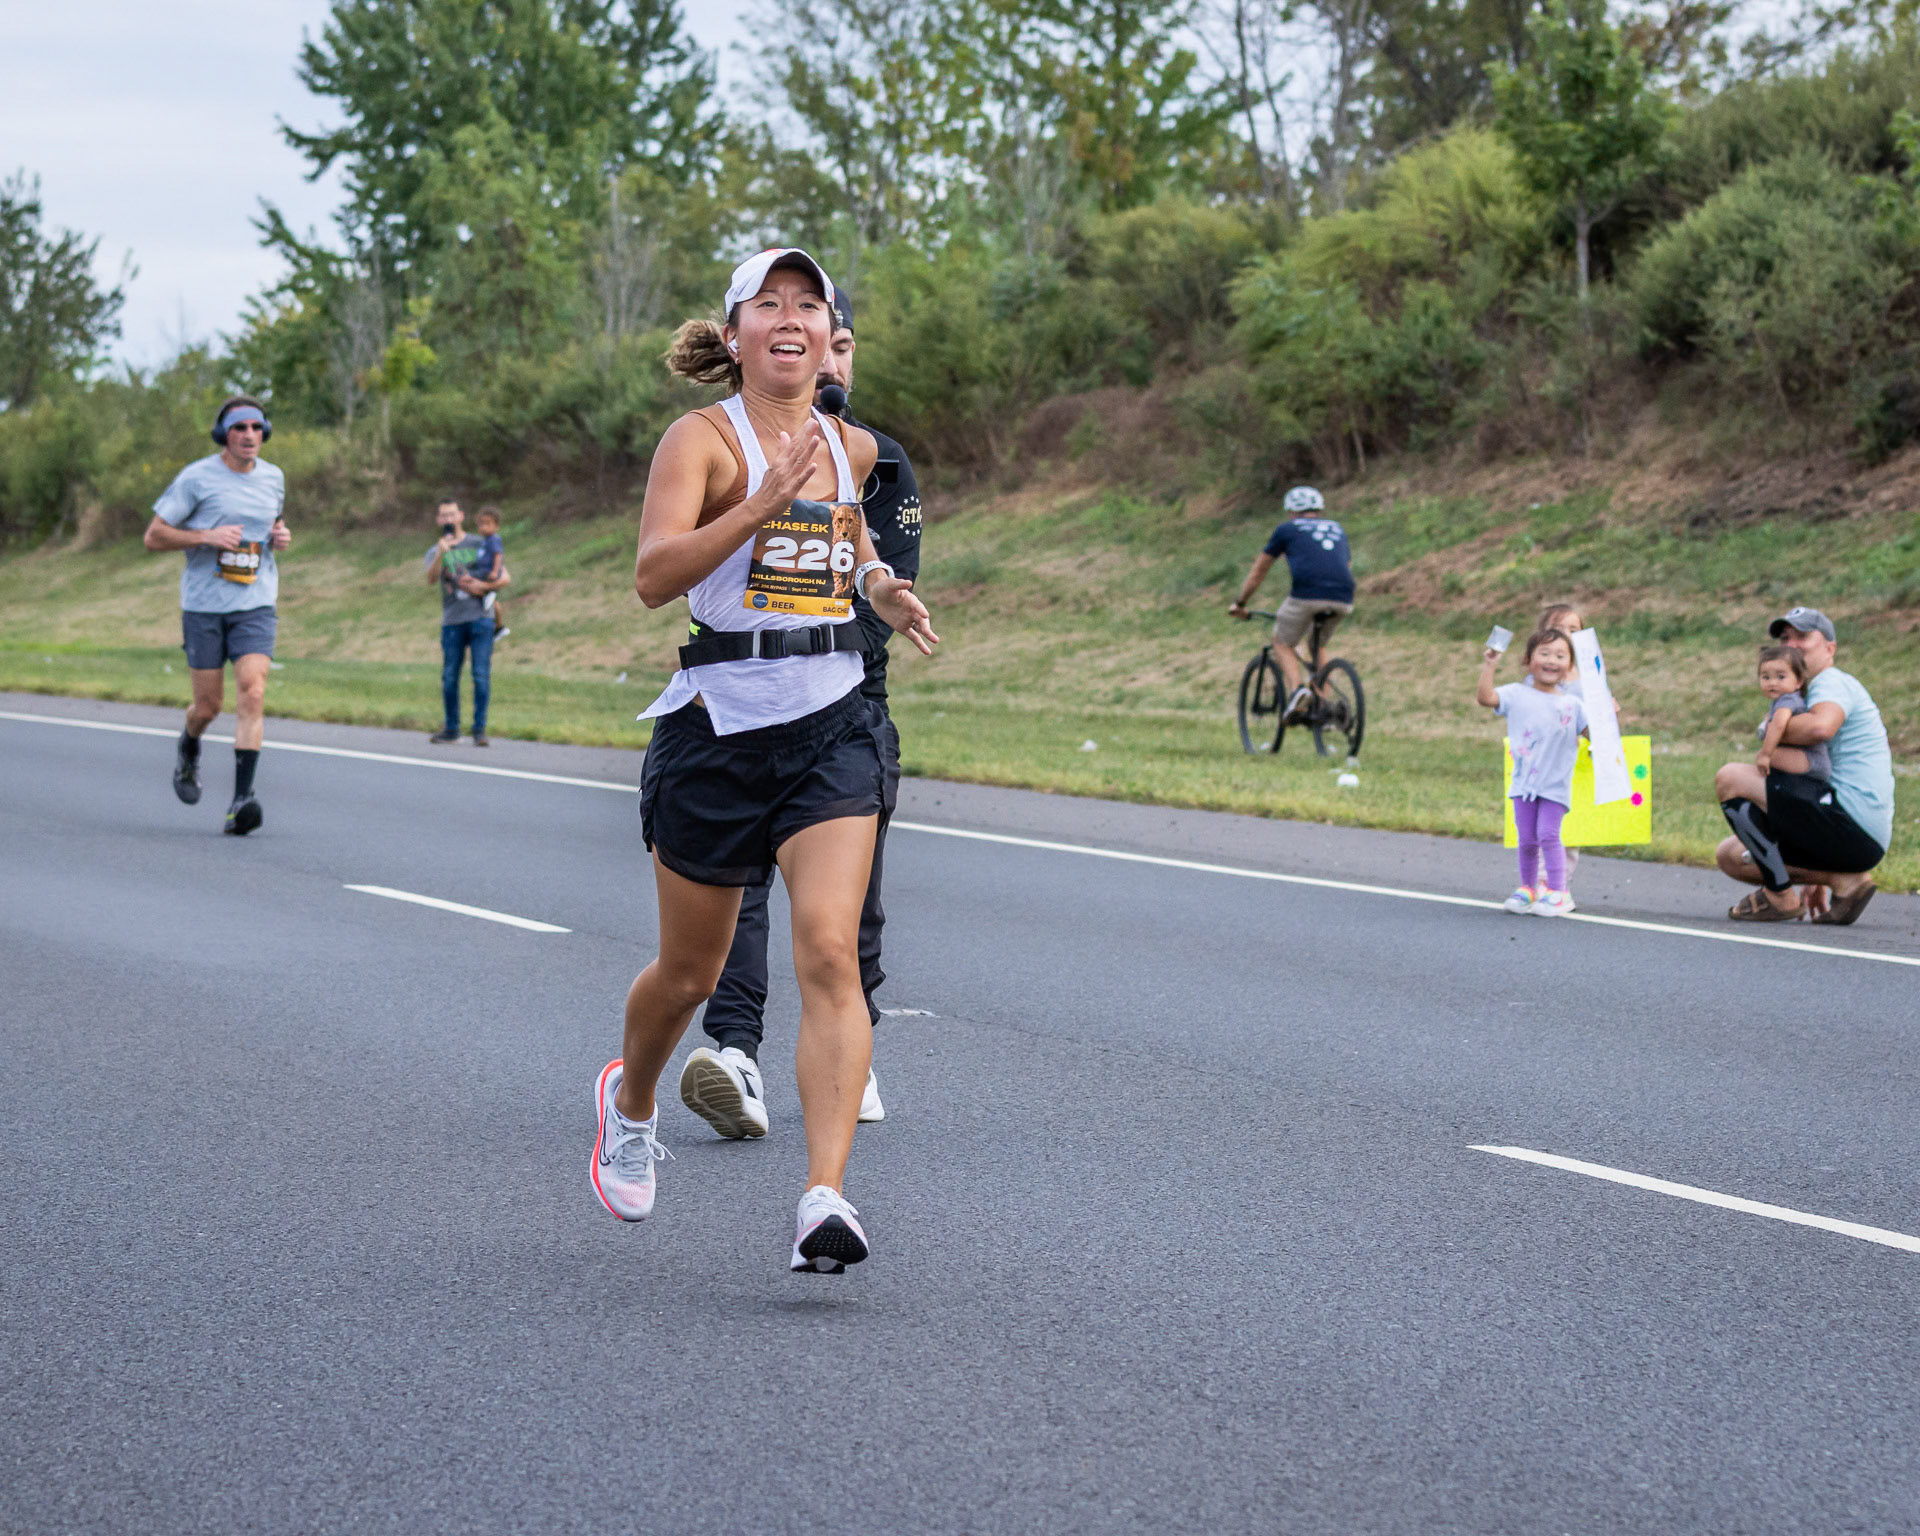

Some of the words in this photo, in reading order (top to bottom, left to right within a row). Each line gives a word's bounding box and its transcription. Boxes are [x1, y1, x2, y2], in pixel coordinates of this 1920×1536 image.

[810, 523, 829, 533] 5K
[762, 536, 855, 573] 226
[751, 573, 815, 584] HILLSBOROUGH
[771, 601, 795, 610] BEER
